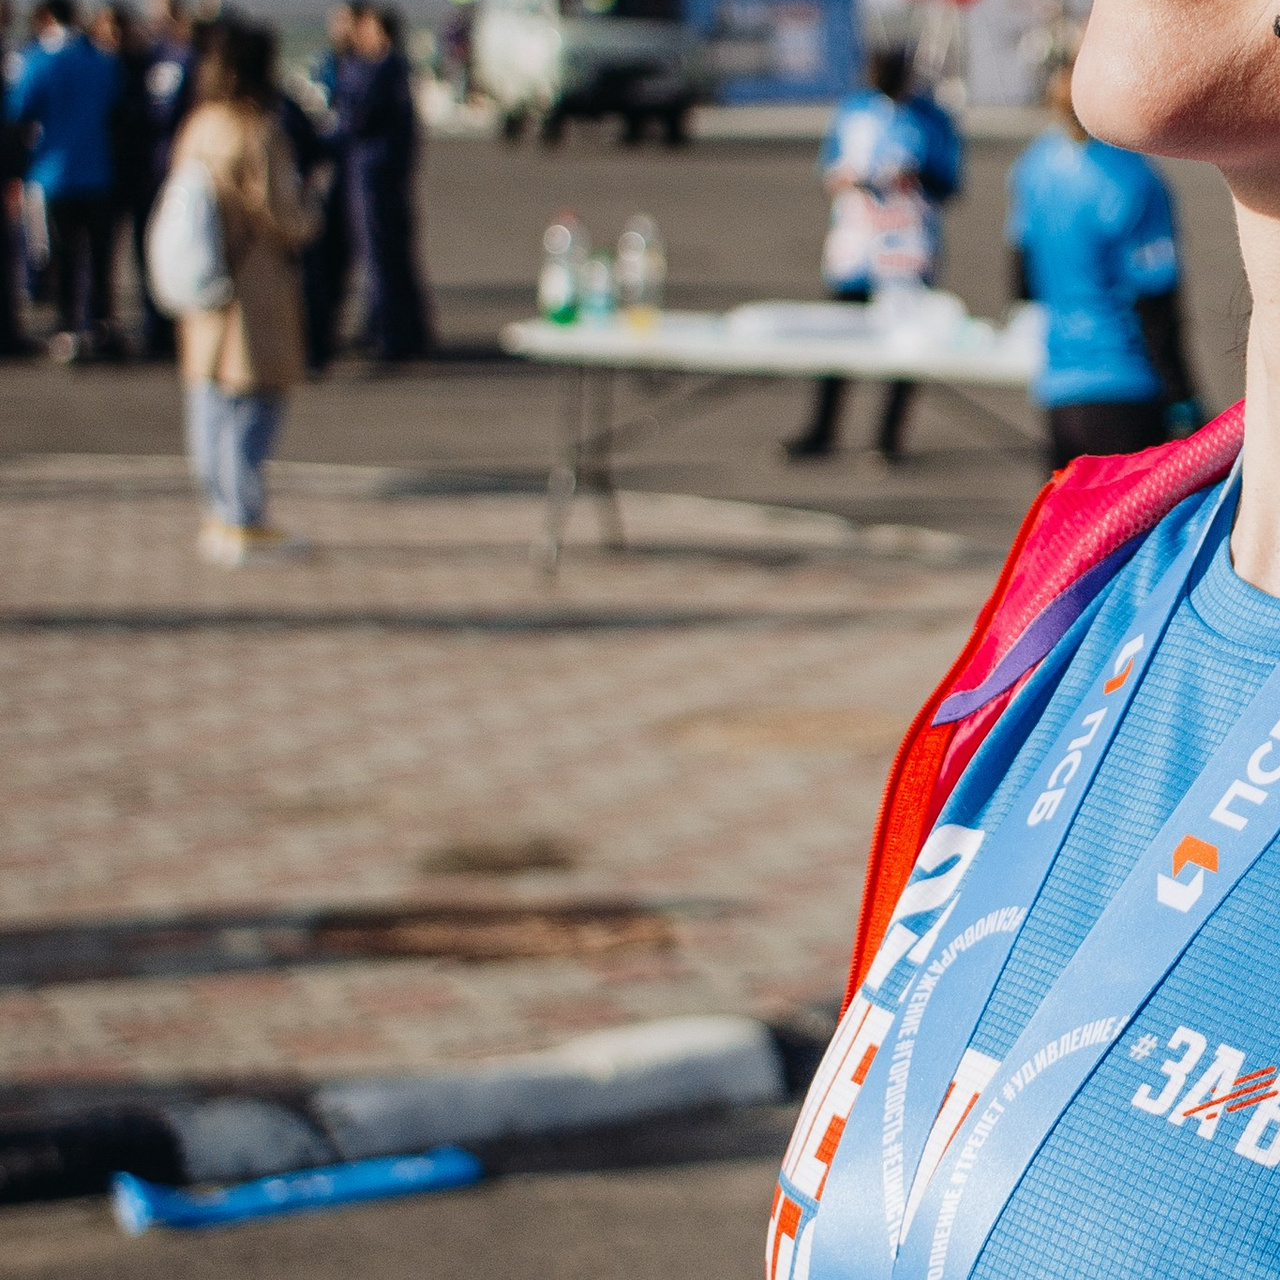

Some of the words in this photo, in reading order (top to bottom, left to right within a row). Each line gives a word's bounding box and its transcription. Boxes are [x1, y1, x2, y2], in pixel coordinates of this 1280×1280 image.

[1027, 707, 1108, 827] ПСБ
[882, 1038, 915, 1146] #ГОРДОСТЬ
[951, 1097, 1005, 1184] #ТРЕПЕТ
[1003, 1015, 1118, 1103] #УДИВЛЕНИЕ
